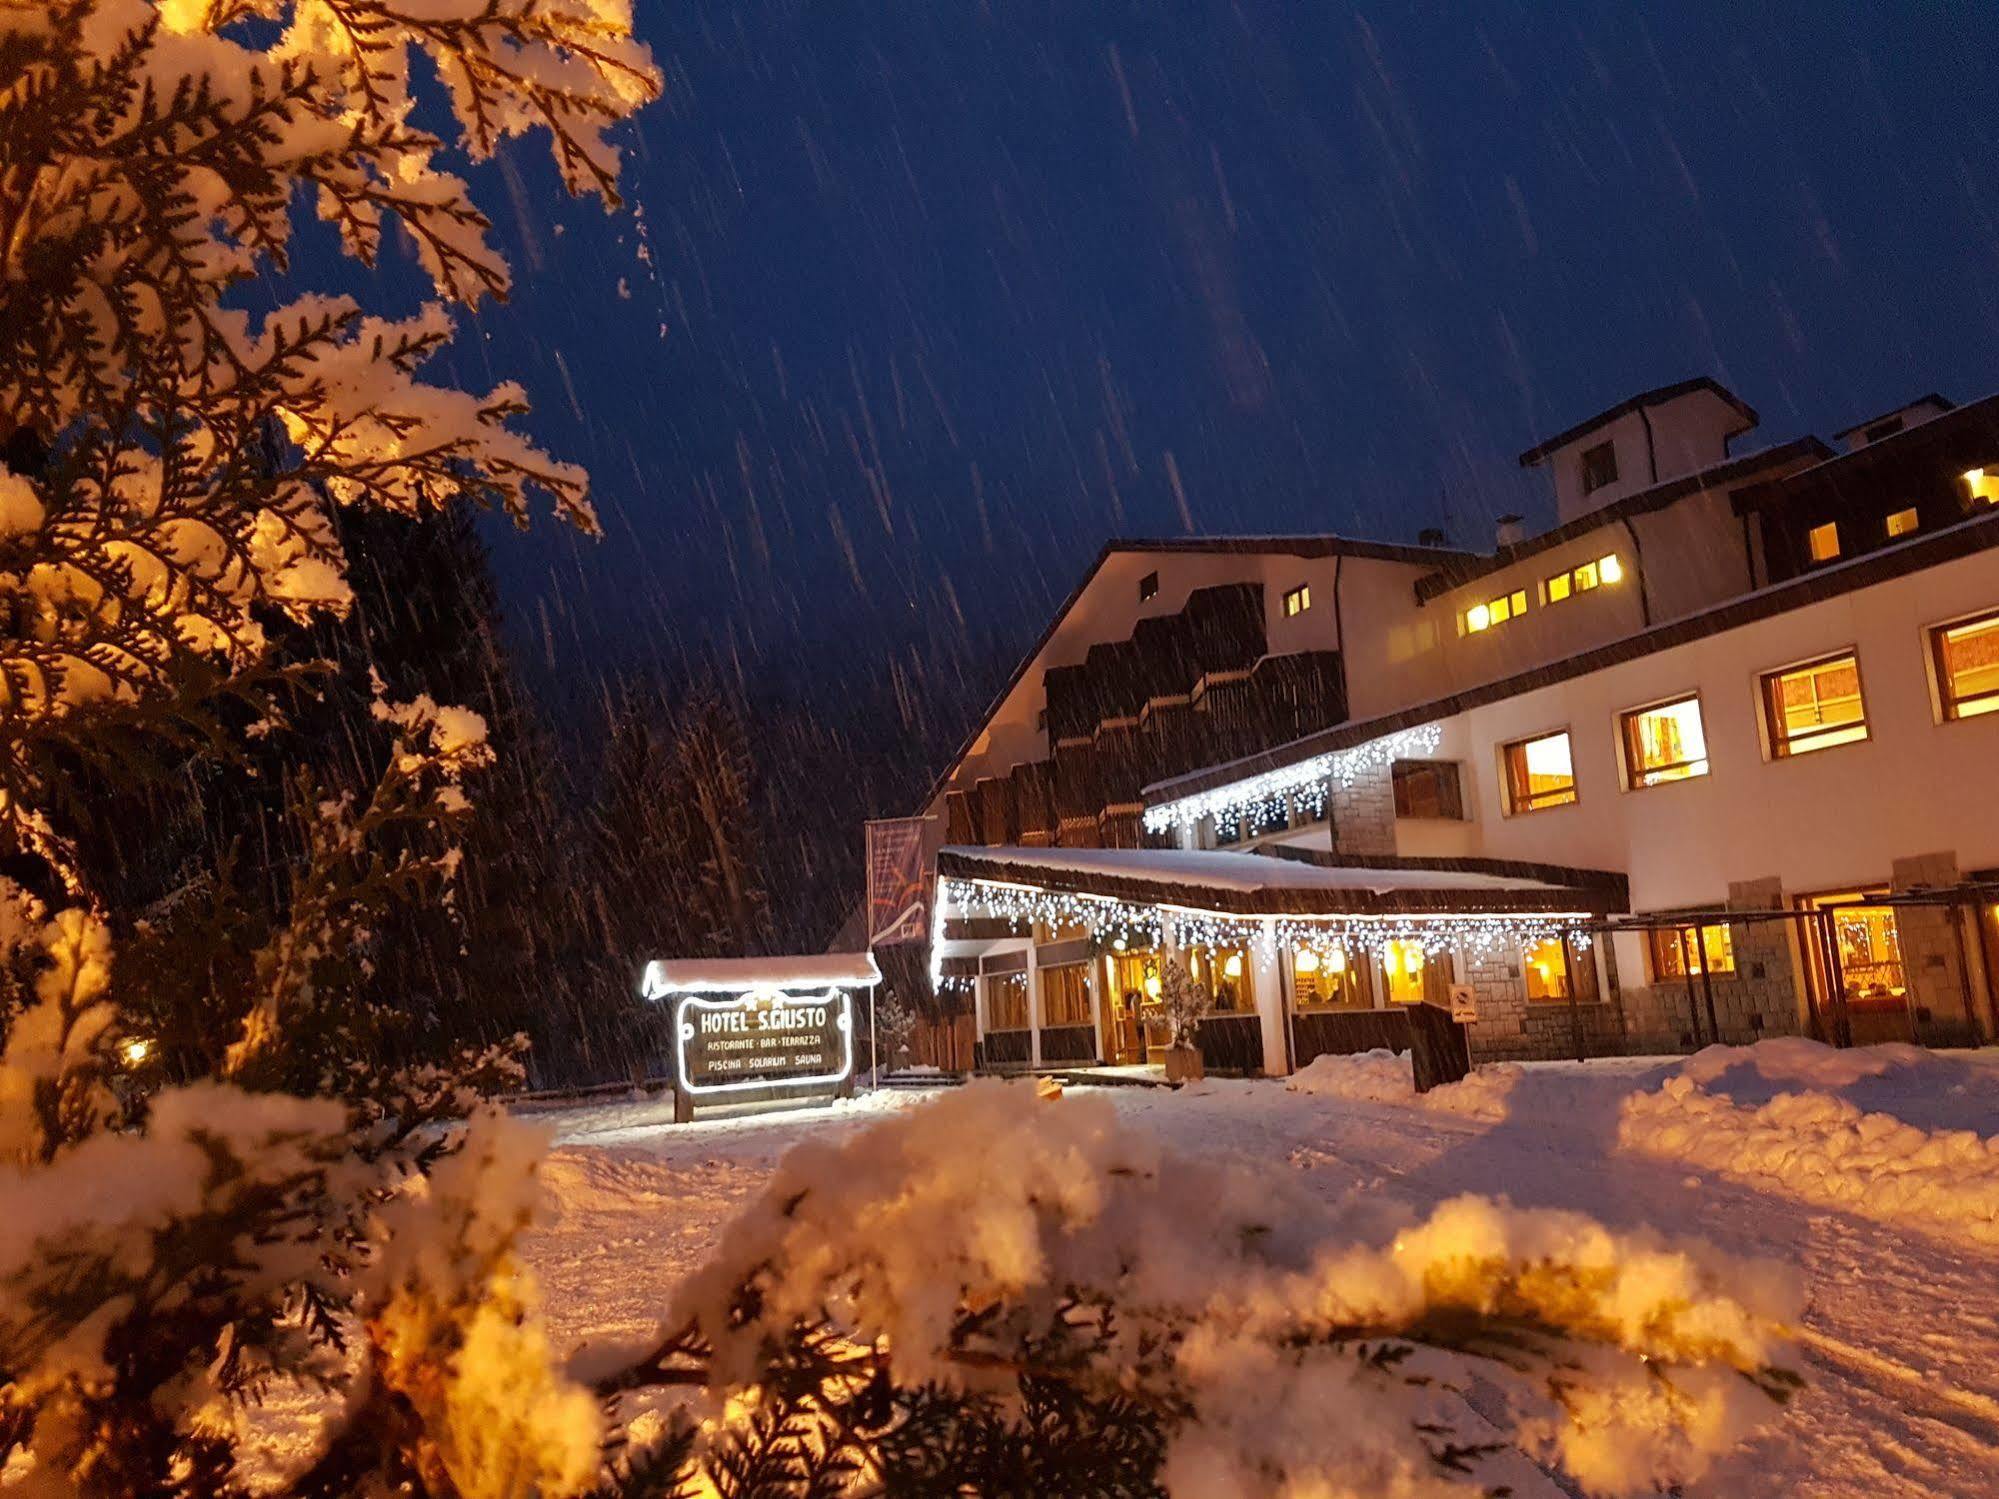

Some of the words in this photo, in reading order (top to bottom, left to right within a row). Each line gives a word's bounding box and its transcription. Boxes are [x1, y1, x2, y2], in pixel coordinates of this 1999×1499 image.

[701, 1011, 748, 1033] HOTEL
[758, 1008, 826, 1030] S.GIUSTO
[708, 1039, 754, 1050] RISTORANTE
[760, 1038, 776, 1047] BAR
[781, 1035, 820, 1046] TERRAZZA
[708, 1059, 740, 1071] PISCINA
[749, 1056, 786, 1067] SOLARIUM
[795, 1054, 822, 1065] SAUNA
